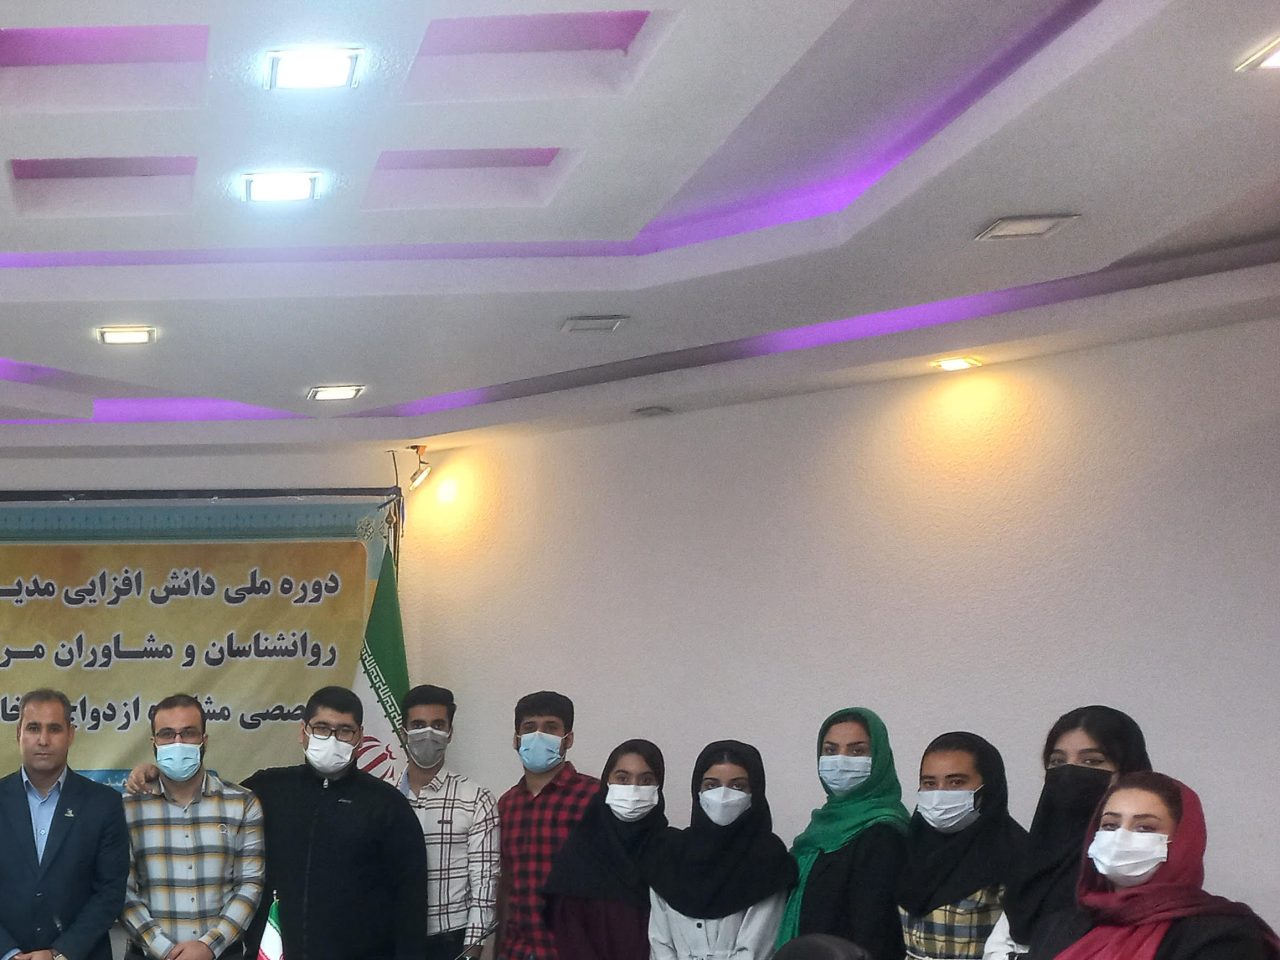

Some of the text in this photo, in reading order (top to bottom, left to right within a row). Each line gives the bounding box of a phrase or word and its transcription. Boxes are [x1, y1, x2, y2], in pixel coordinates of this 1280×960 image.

[62, 568, 143, 607] افزایی
[149, 569, 217, 606] دانش
[223, 568, 272, 605] ملی
[279, 572, 340, 605] دوره
[52, 632, 174, 669] مشاوران
[180, 643, 197, 668] و
[203, 630, 337, 668] روانشناسان
[239, 703, 307, 731] صصی
